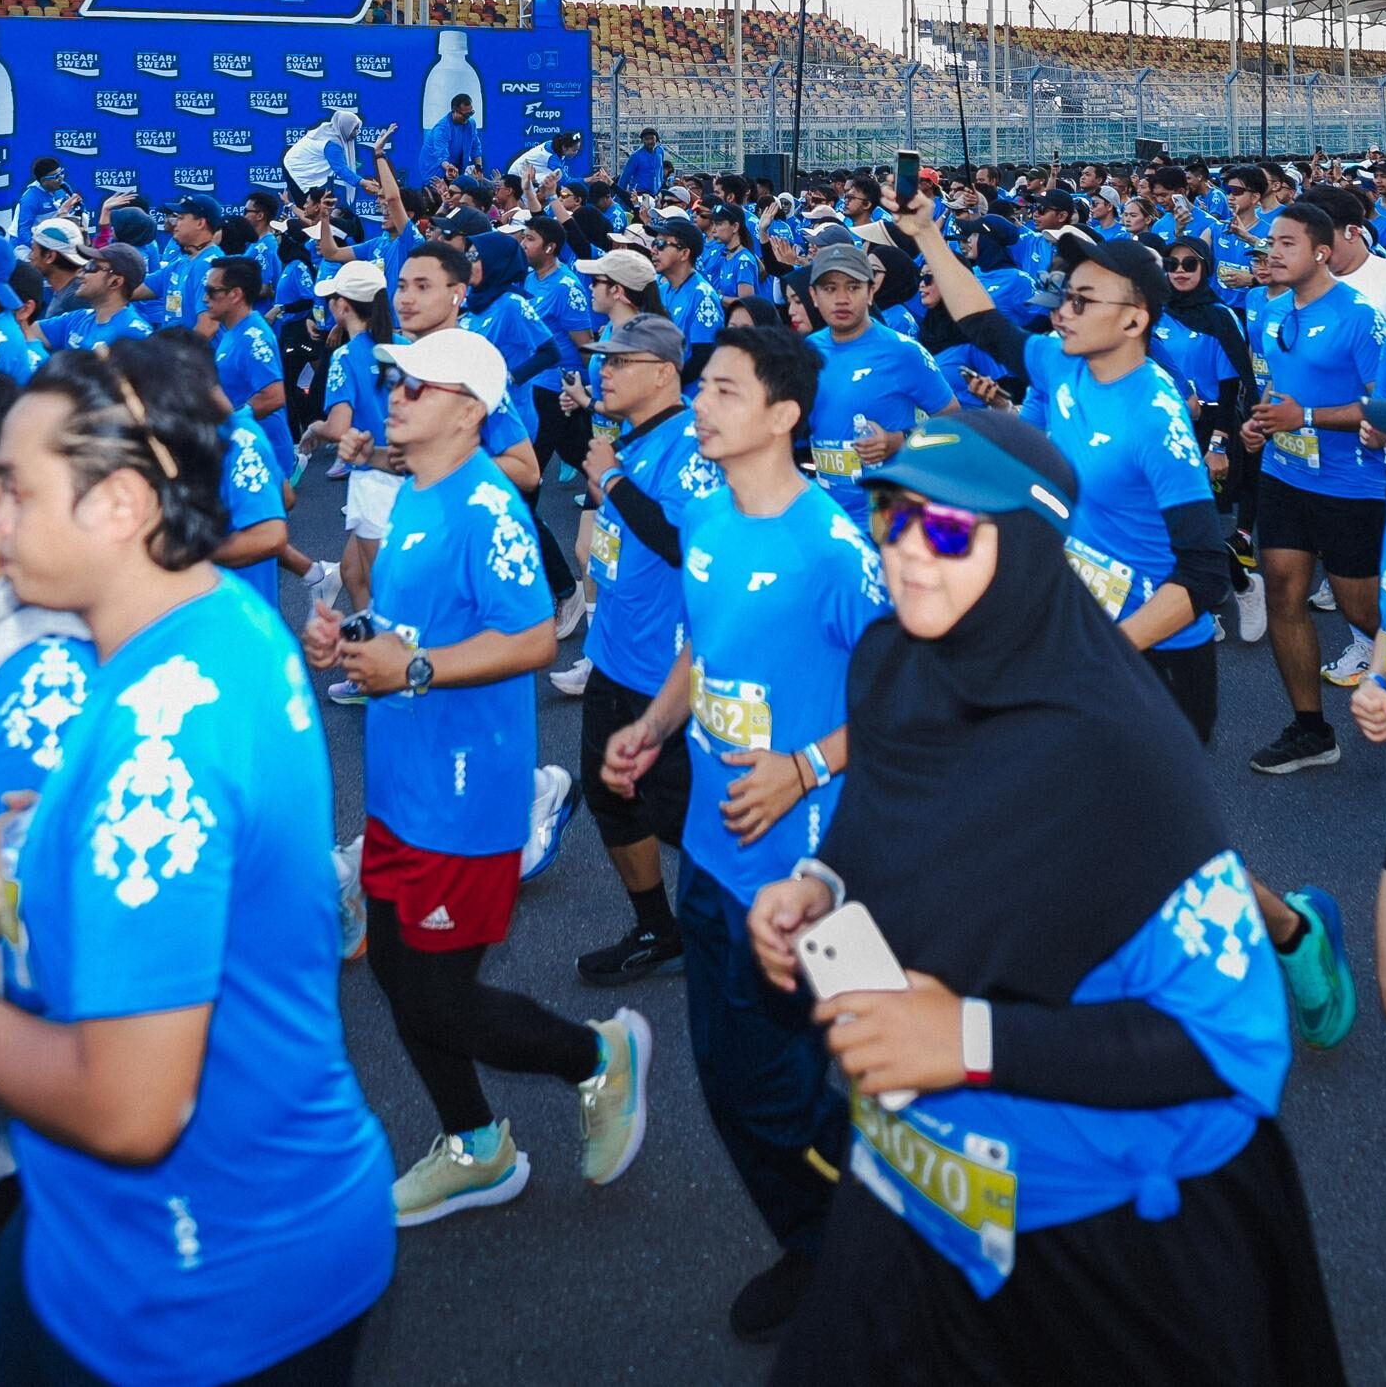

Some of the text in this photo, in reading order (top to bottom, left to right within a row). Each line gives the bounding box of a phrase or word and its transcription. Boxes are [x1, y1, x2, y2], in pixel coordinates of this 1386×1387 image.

[57, 60, 93, 68] SWEAT
[502, 83, 540, 93] RANS
[535, 110, 561, 120] erspo
[533, 125, 561, 134] Rexona
